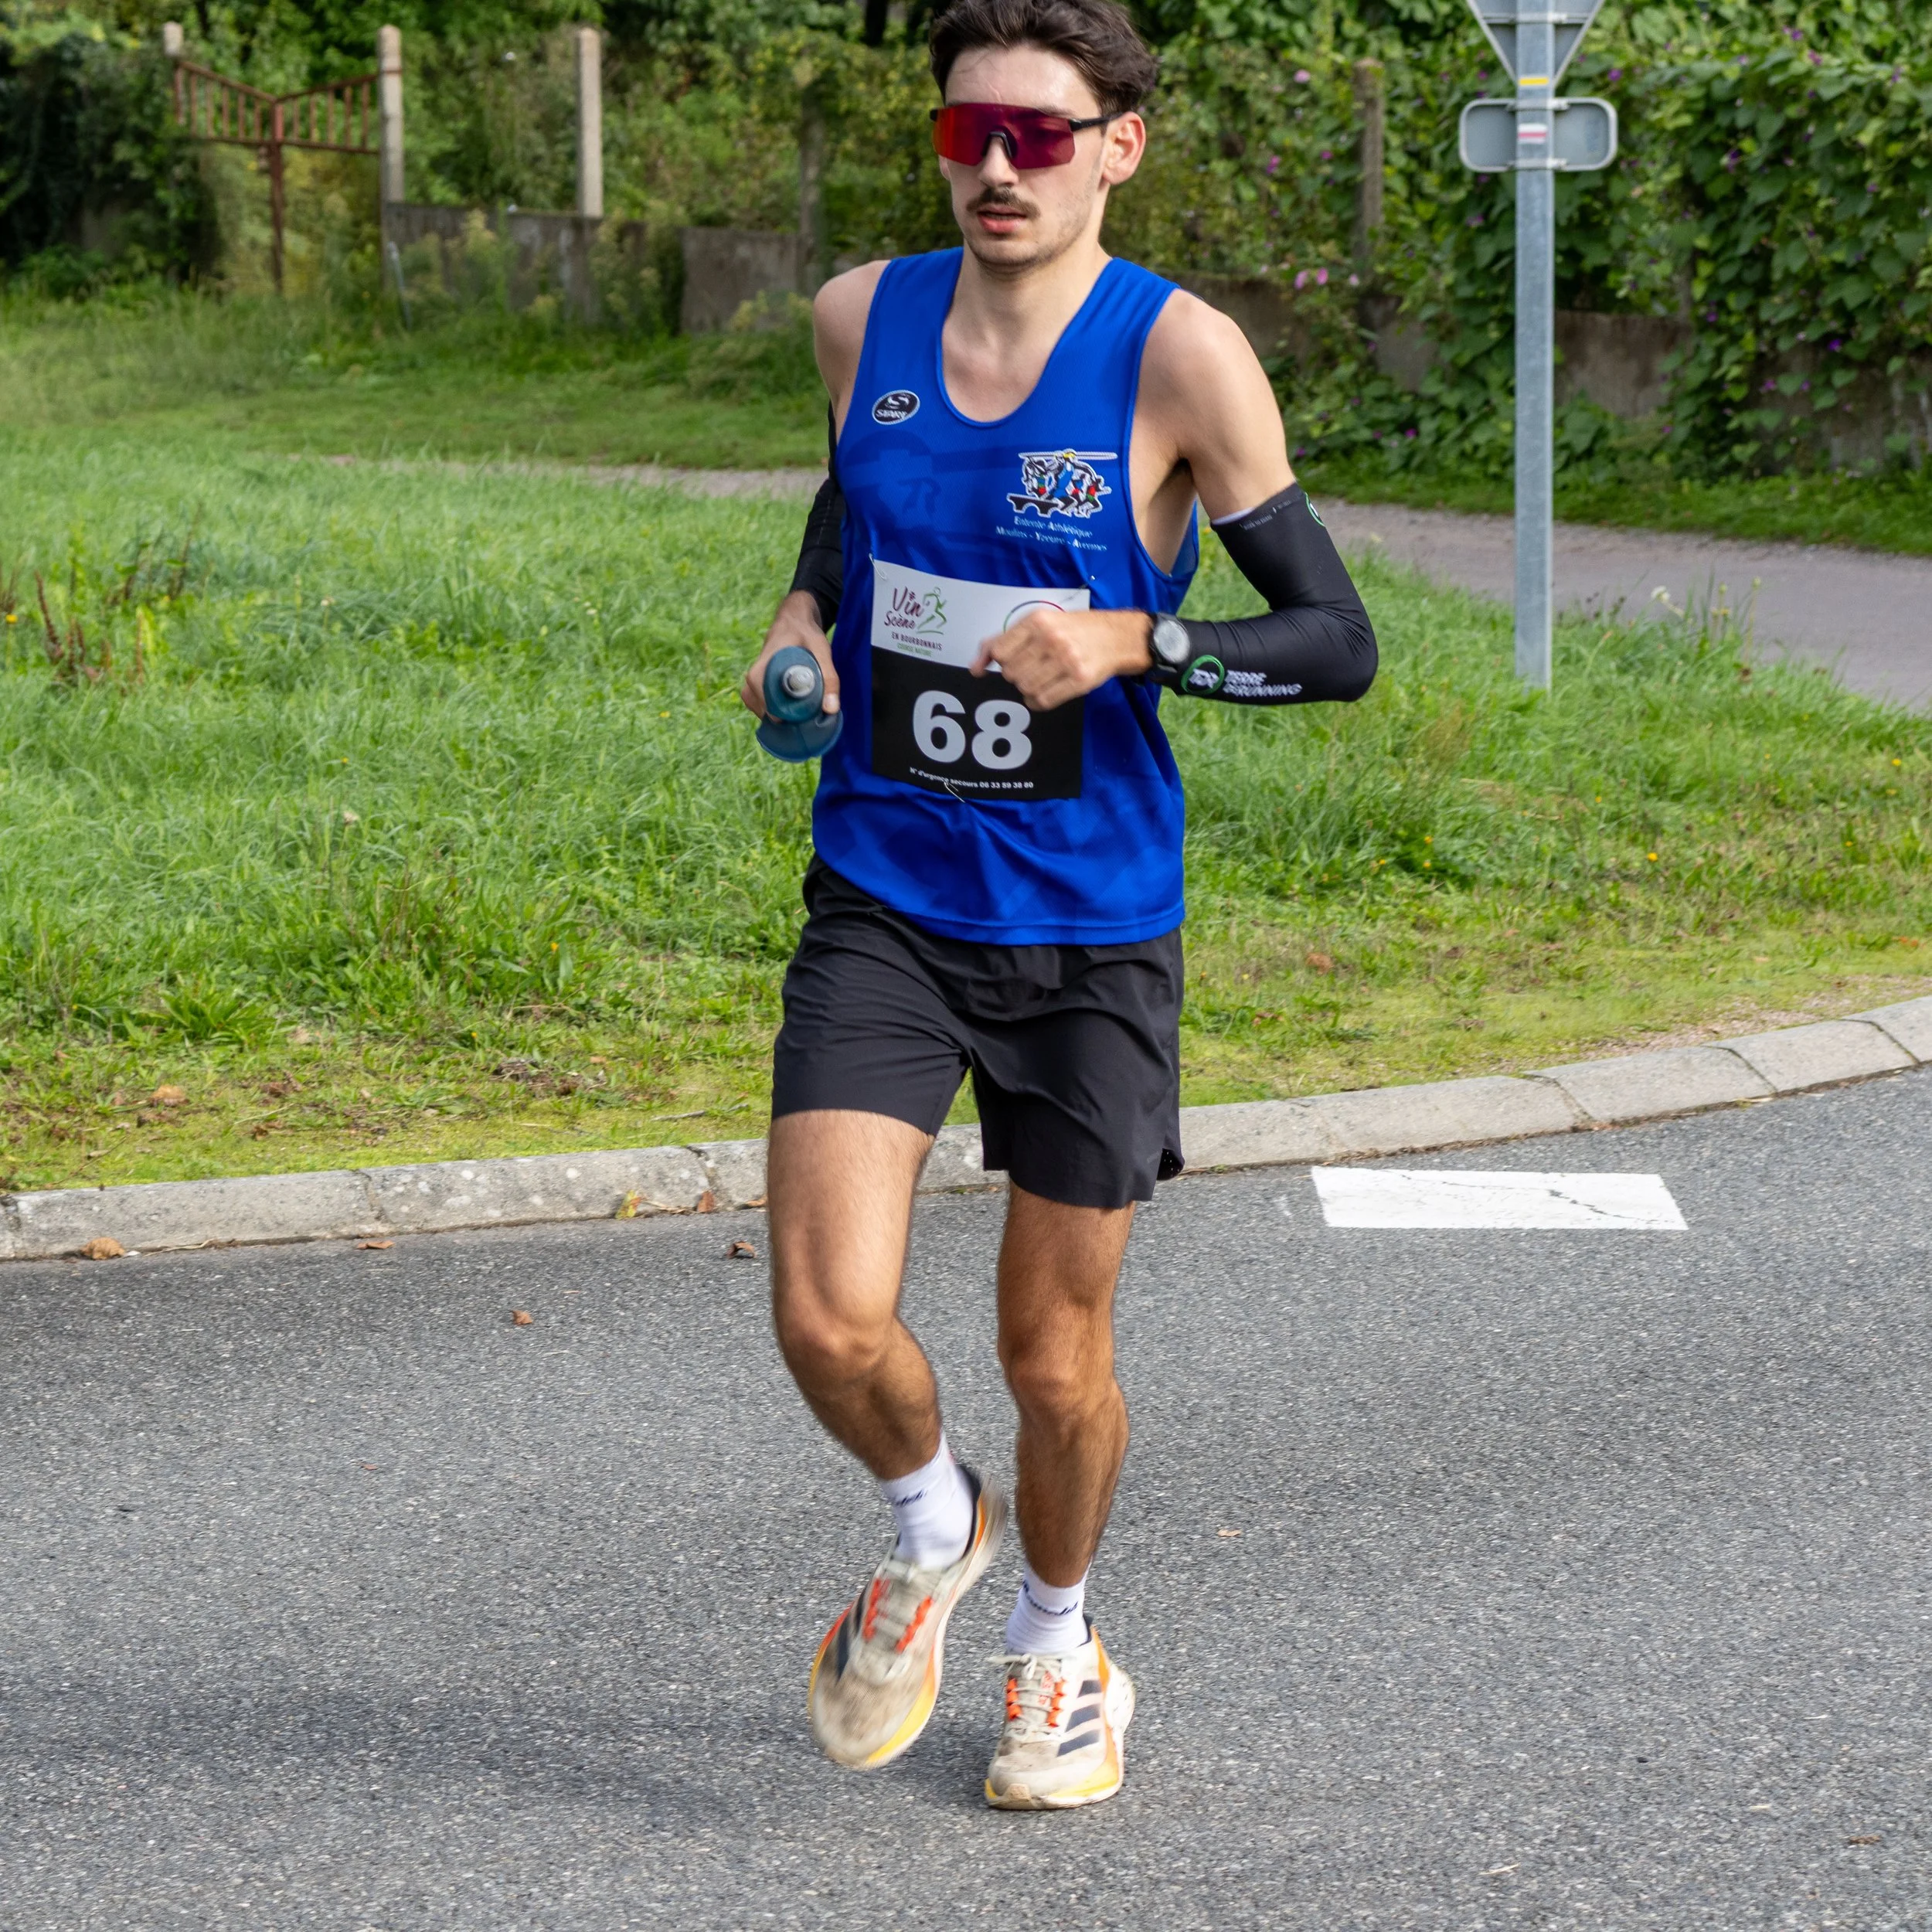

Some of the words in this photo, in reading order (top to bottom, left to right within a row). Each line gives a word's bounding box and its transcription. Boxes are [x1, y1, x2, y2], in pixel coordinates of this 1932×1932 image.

[893, 587, 924, 617] Vin
[884, 611, 916, 629] Scène
[892, 631, 900, 641] EN
[900, 634, 942, 651] BOURBONNAIS
[913, 690, 1032, 770] 68
[950, 778, 978, 788] secours
